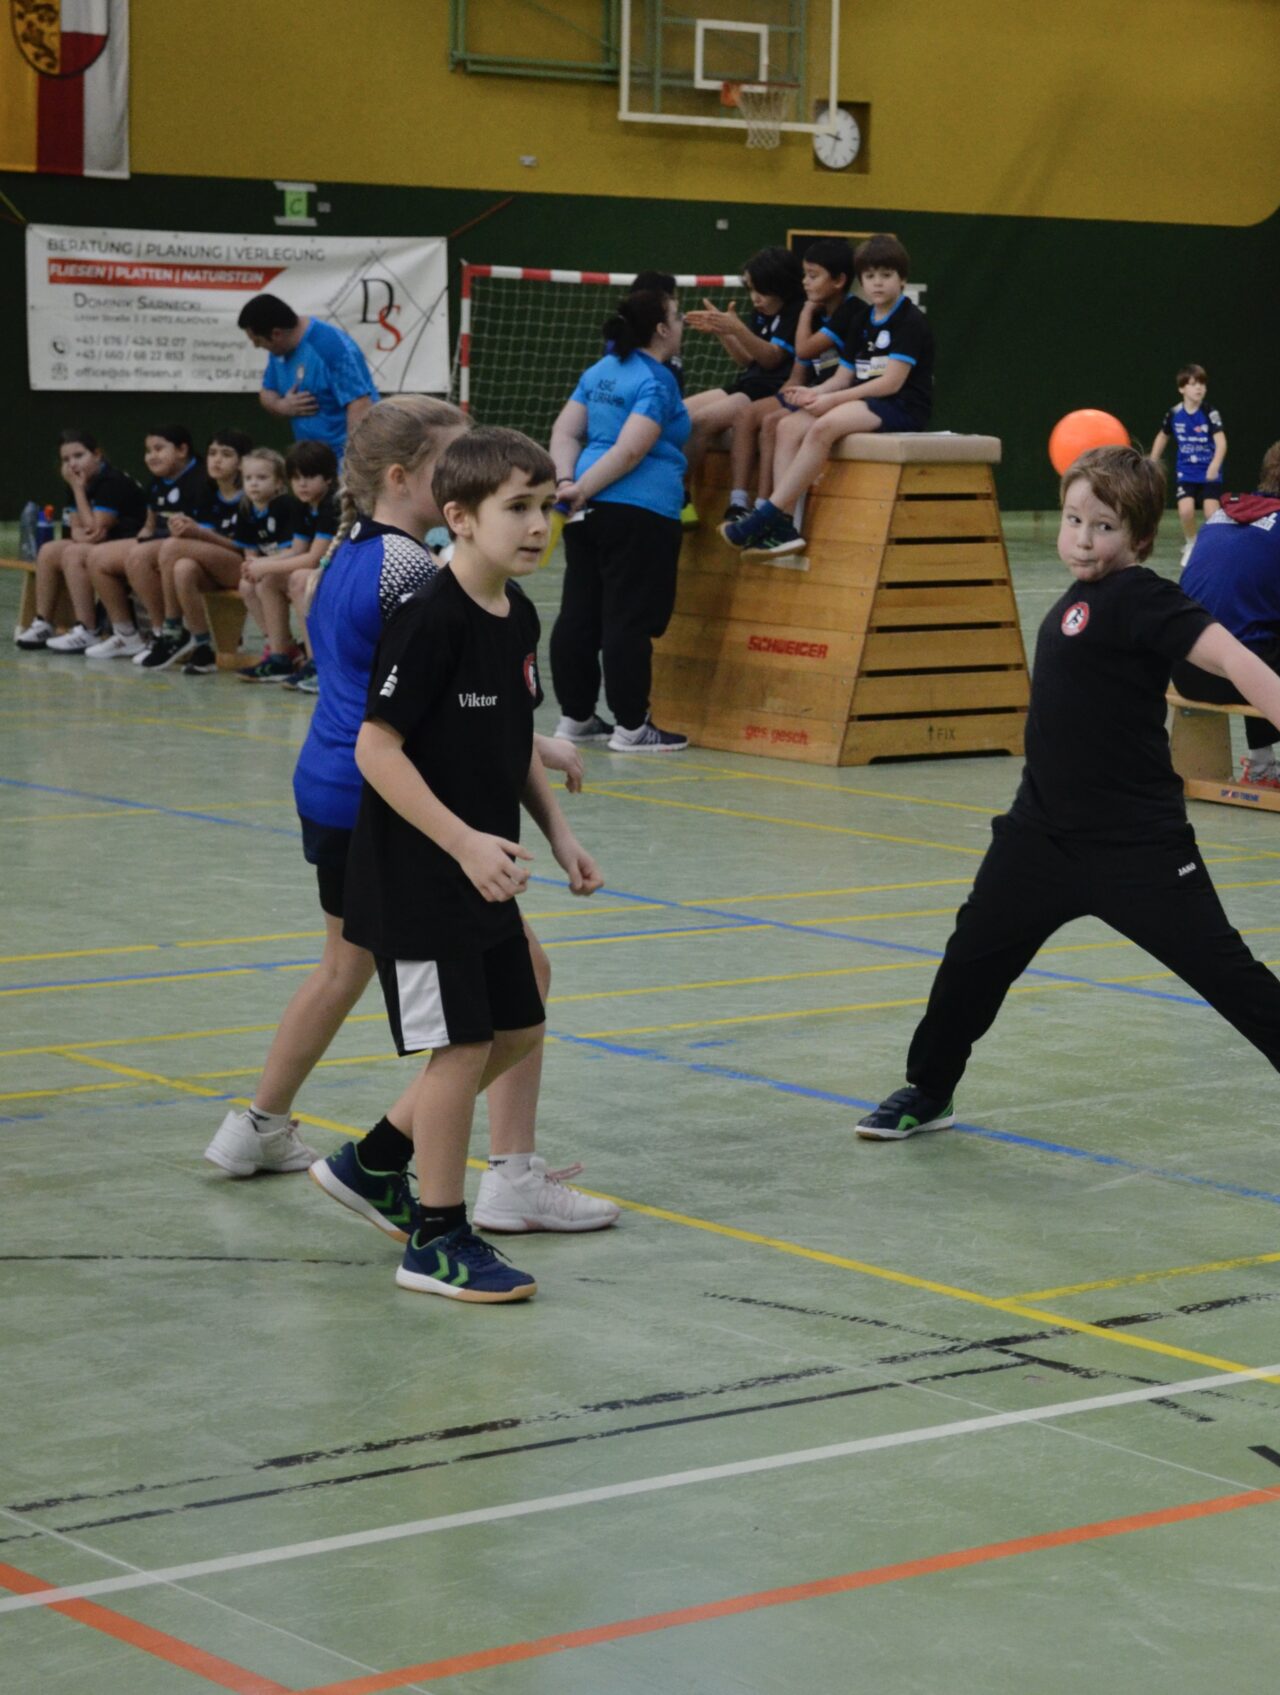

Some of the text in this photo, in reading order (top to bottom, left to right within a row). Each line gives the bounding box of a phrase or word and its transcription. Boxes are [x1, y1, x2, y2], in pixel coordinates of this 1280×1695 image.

[47, 238, 134, 255] BERATUNG
[146, 242, 223, 258] PLANUNG
[235, 247, 325, 261] VERLEGUNG
[48, 263, 106, 278] FLIESEN
[115, 266, 173, 281] PLATTEN
[181, 270, 264, 283] NATURSTEIN
[458, 693, 498, 707] Viktor
[937, 727, 956, 741] FIX
